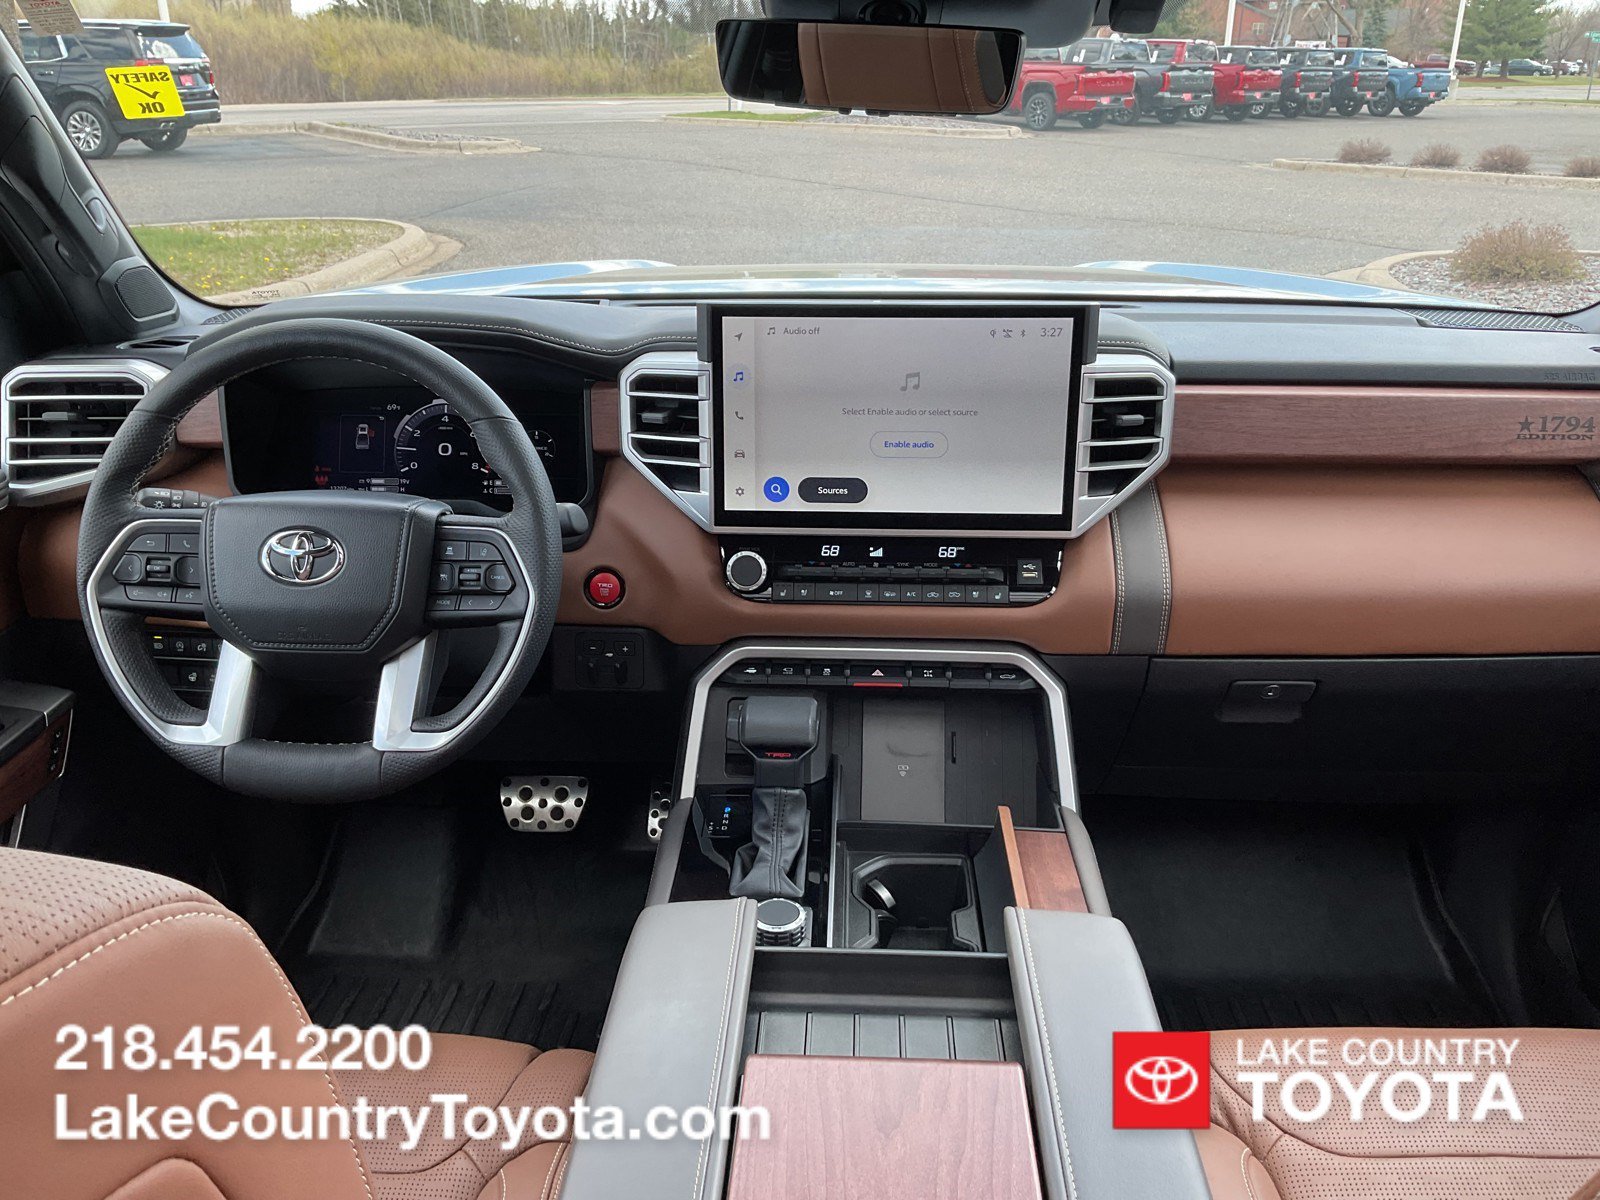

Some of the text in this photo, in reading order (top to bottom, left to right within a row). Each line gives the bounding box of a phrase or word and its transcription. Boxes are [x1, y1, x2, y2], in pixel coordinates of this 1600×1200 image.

[783, 326, 820, 336] Audio off
[1040, 327, 1063, 337] 3:27
[841, 407, 978, 417] Select Enable audio or select source
[441, 415, 449, 423] 4
[1539, 415, 1596, 433] 1794
[413, 429, 421, 437] 2
[1516, 433, 1595, 441] EDITION
[438, 442, 452, 456] 0
[883, 439, 934, 449] Enable audio
[410, 461, 418, 469] 0
[471, 462, 479, 470] 8
[817, 486, 848, 495] Sources
[821, 545, 840, 556] 68
[938, 546, 957, 558] 68
